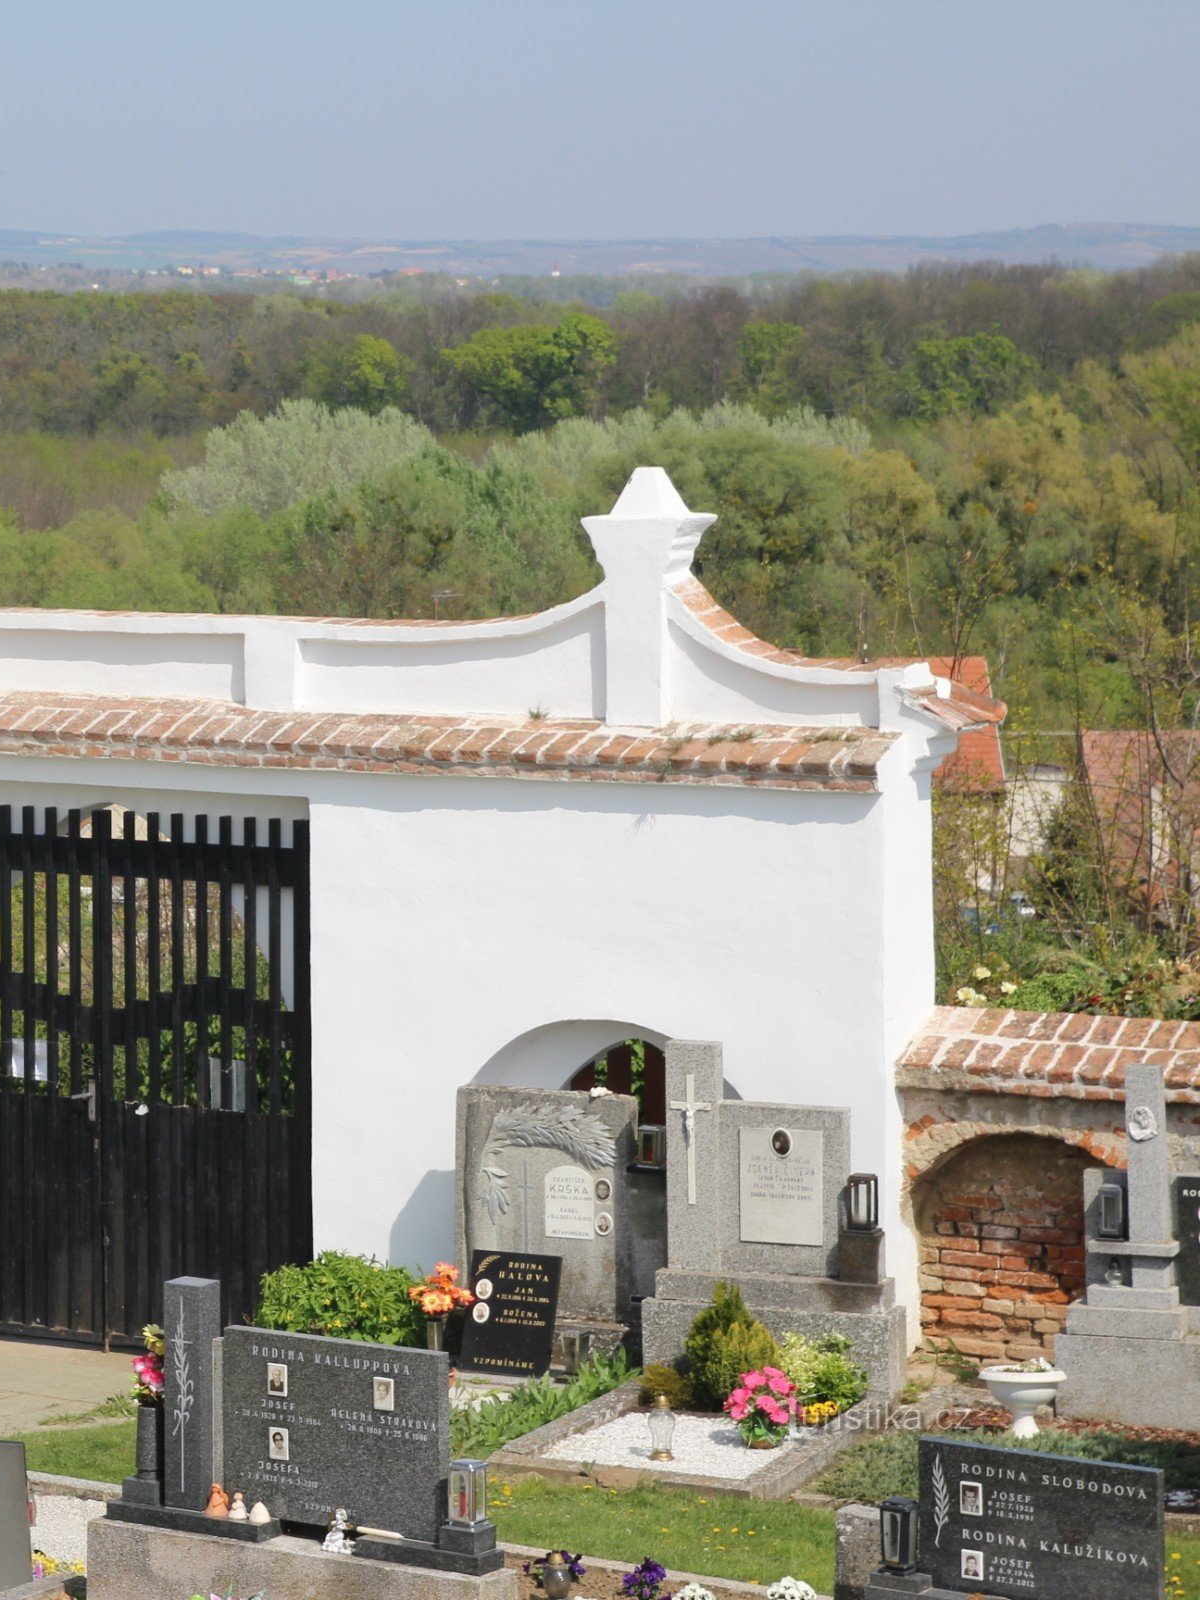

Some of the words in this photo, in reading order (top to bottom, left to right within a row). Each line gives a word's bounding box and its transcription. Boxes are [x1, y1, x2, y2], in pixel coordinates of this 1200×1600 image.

[550, 1183, 588, 1194] KRŠKA
[508, 1261, 542, 1270] RODINA
[498, 1270, 548, 1282] HALOVA
[514, 1286, 534, 1294] JAN
[503, 1308, 538, 1318] BOŽENA
[252, 1345, 305, 1362] RODINA
[314, 1353, 410, 1376] KALLUPPOVA
[473, 1356, 535, 1370] VZPOMÍNÁME
[260, 1398, 295, 1410] JOSEF
[330, 1408, 372, 1422] HELENA
[258, 1460, 300, 1474] JOSEFA
[960, 1462, 1028, 1482] RODINA
[1040, 1474, 1148, 1500] SLOBODOVA
[990, 1490, 1032, 1504] JOSEF
[962, 1528, 1027, 1549] RODINA
[1040, 1540, 1149, 1568] KALUŽÍKOVA
[992, 1556, 1032, 1570] JOSEF
